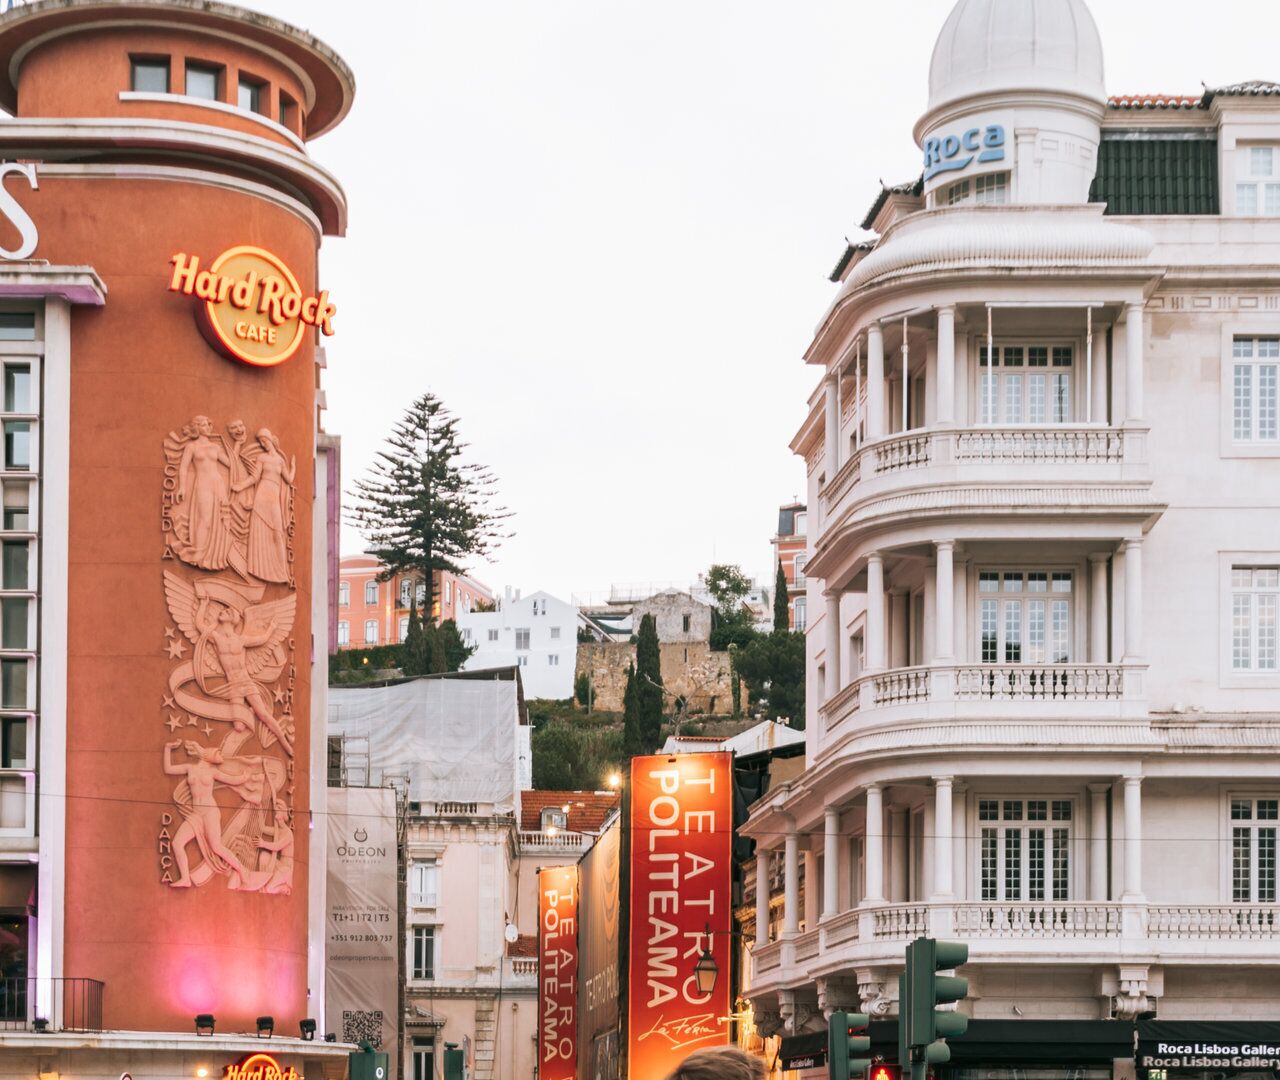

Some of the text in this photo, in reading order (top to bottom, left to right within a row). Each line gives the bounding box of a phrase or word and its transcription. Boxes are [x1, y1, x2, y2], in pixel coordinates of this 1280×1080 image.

[923, 125, 1005, 168] Roca
[169, 252, 337, 337] Hard Rock
[235, 321, 277, 344] CAFE
[158, 812, 173, 883] DANÇA
[337, 846, 386, 857] ODEON
[647, 769, 680, 1008] POLITEAMA
[682, 768, 716, 1004] TEATRO
[331, 934, 347, 942] +351
[350, 934, 363, 942] 912
[332, 913, 354, 921] T1+1
[362, 913, 371, 921] T2
[544, 889, 559, 1062] POLITEAMA
[559, 887, 574, 1060] TEATRO
[1143, 1055, 1180, 1067] Roca
[1182, 1056, 1230, 1067] Lisboa
[1158, 1043, 1192, 1054] Roca
[1195, 1043, 1238, 1055] Lisboa
